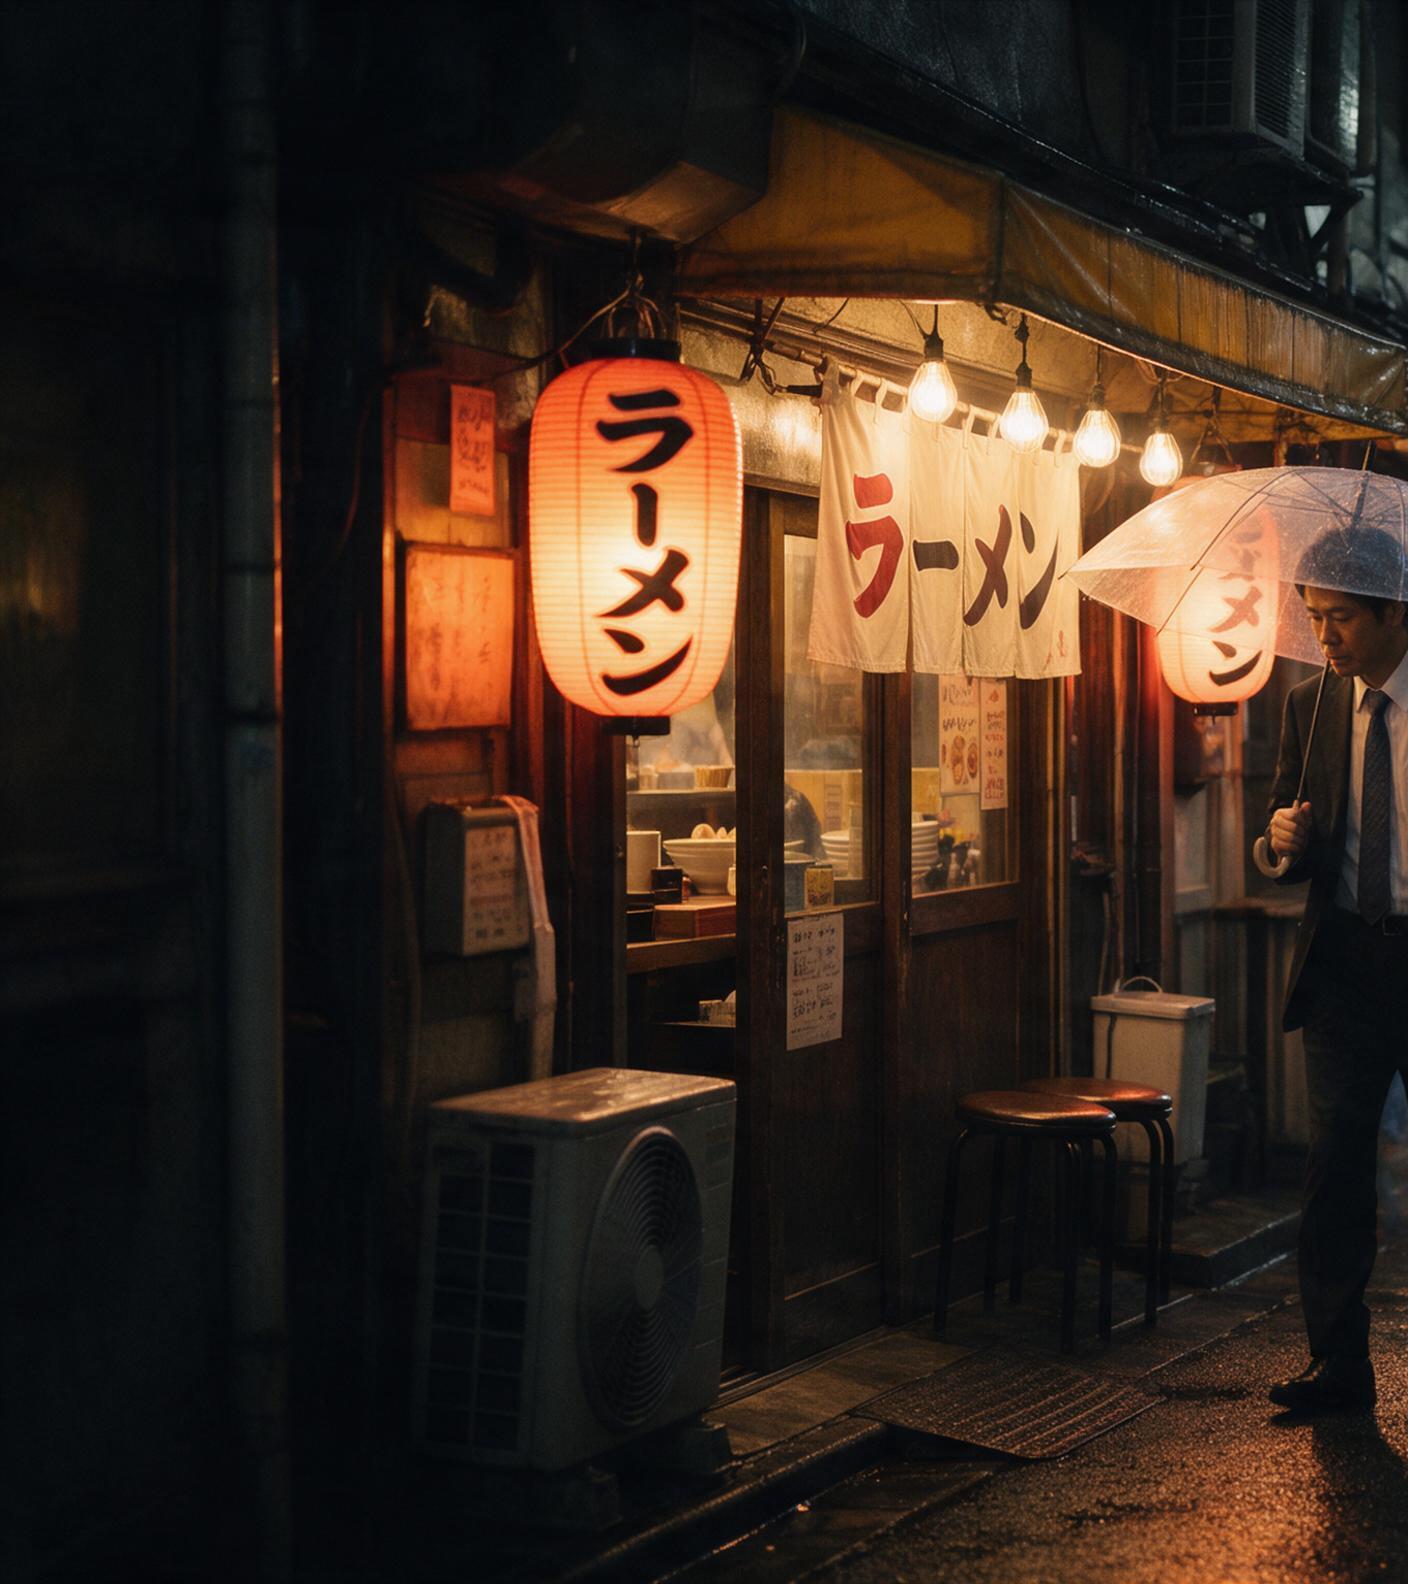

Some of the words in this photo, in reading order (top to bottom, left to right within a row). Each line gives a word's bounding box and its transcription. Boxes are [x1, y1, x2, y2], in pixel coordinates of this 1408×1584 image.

[595, 388, 694, 696] ラーメン
[846, 473, 1058, 630] ラーメン
